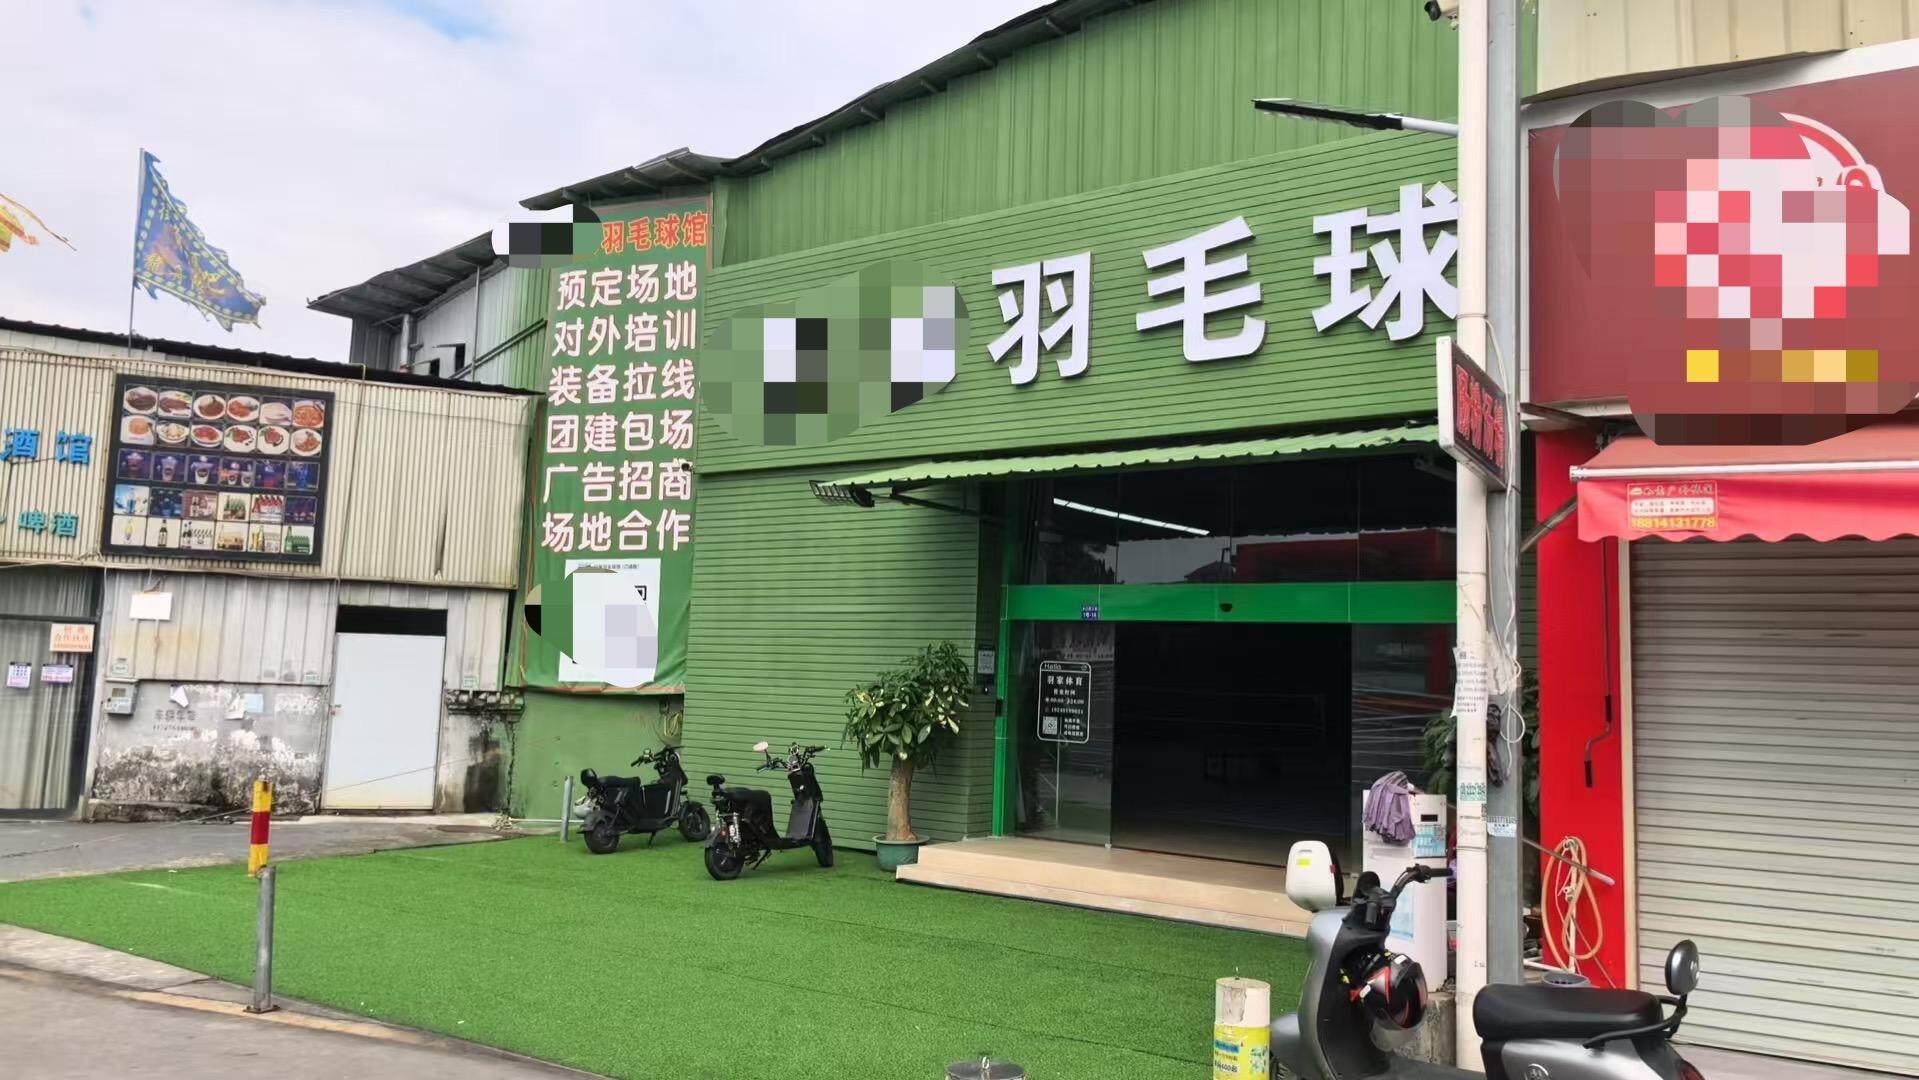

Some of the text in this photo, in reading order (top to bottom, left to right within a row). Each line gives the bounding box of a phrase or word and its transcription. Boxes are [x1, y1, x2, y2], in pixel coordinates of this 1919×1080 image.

[601, 211, 709, 255] 羽毛球馆
[557, 260, 697, 310] 预定场地
[987, 182, 1457, 385] 羽毛球
[552, 308, 696, 357] 对外培训
[548, 358, 695, 406] 装备拉线
[0, 427, 92, 466] 酒馆
[546, 409, 693, 453] 团建包场
[543, 458, 693, 503] 广告招商
[18, 508, 79, 539] 啤酒
[542, 509, 691, 552] 场地合作
